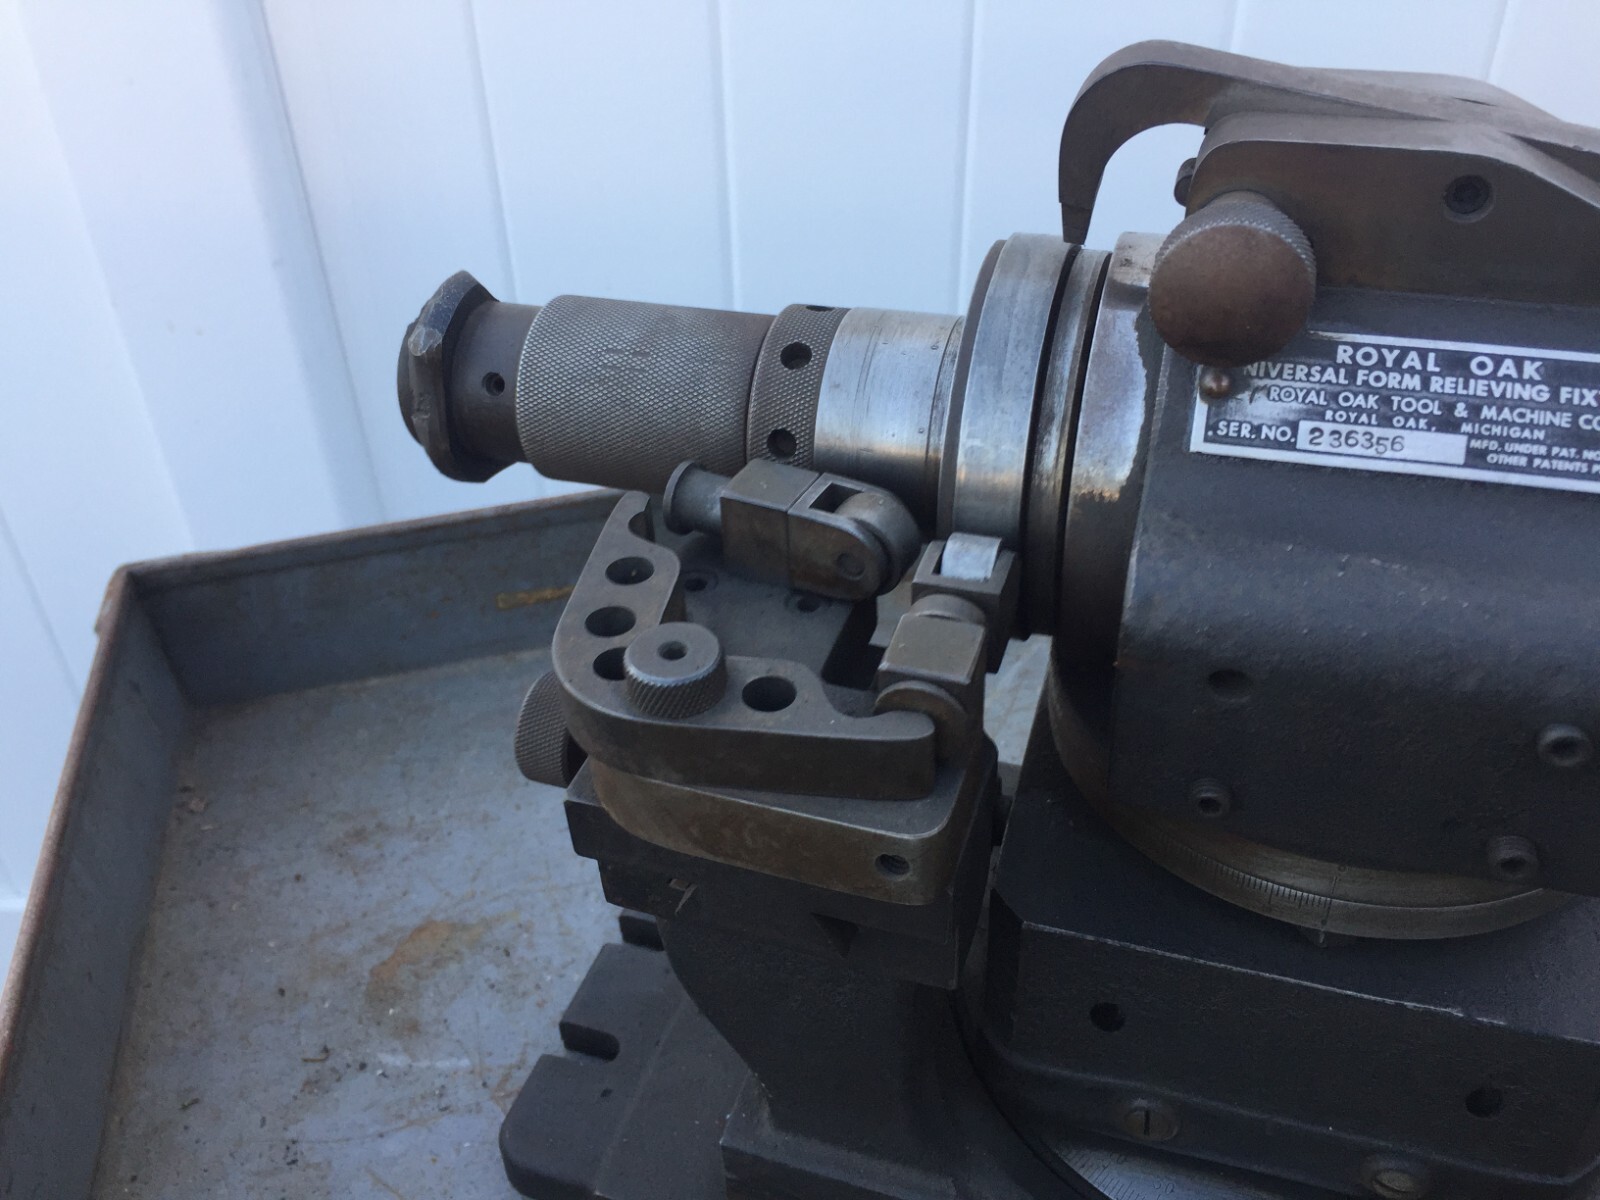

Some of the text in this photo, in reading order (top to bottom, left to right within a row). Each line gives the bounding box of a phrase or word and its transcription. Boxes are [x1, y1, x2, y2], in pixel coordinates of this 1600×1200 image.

[1336, 345, 1543, 380] ROYAL OAK
[1243, 361, 1600, 407] NIVERSAL FORM RELIEVING FIX
[1269, 385, 1327, 406] ROYAL
[1338, 391, 1379, 409] OAK
[1391, 395, 1442, 415] TOOL
[1454, 402, 1468, 418] &
[1480, 405, 1573, 428] MACHINE
[1261, 426, 1296, 443] NO.
[1308, 427, 1405, 454] 236356
[1325, 410, 1546, 440] ROYAL OAK, MICHIGAN
[1486, 453, 1528, 467] OTHER
[1532, 458, 1588, 473] PATENTS
[1504, 442, 1548, 456] UNDER
